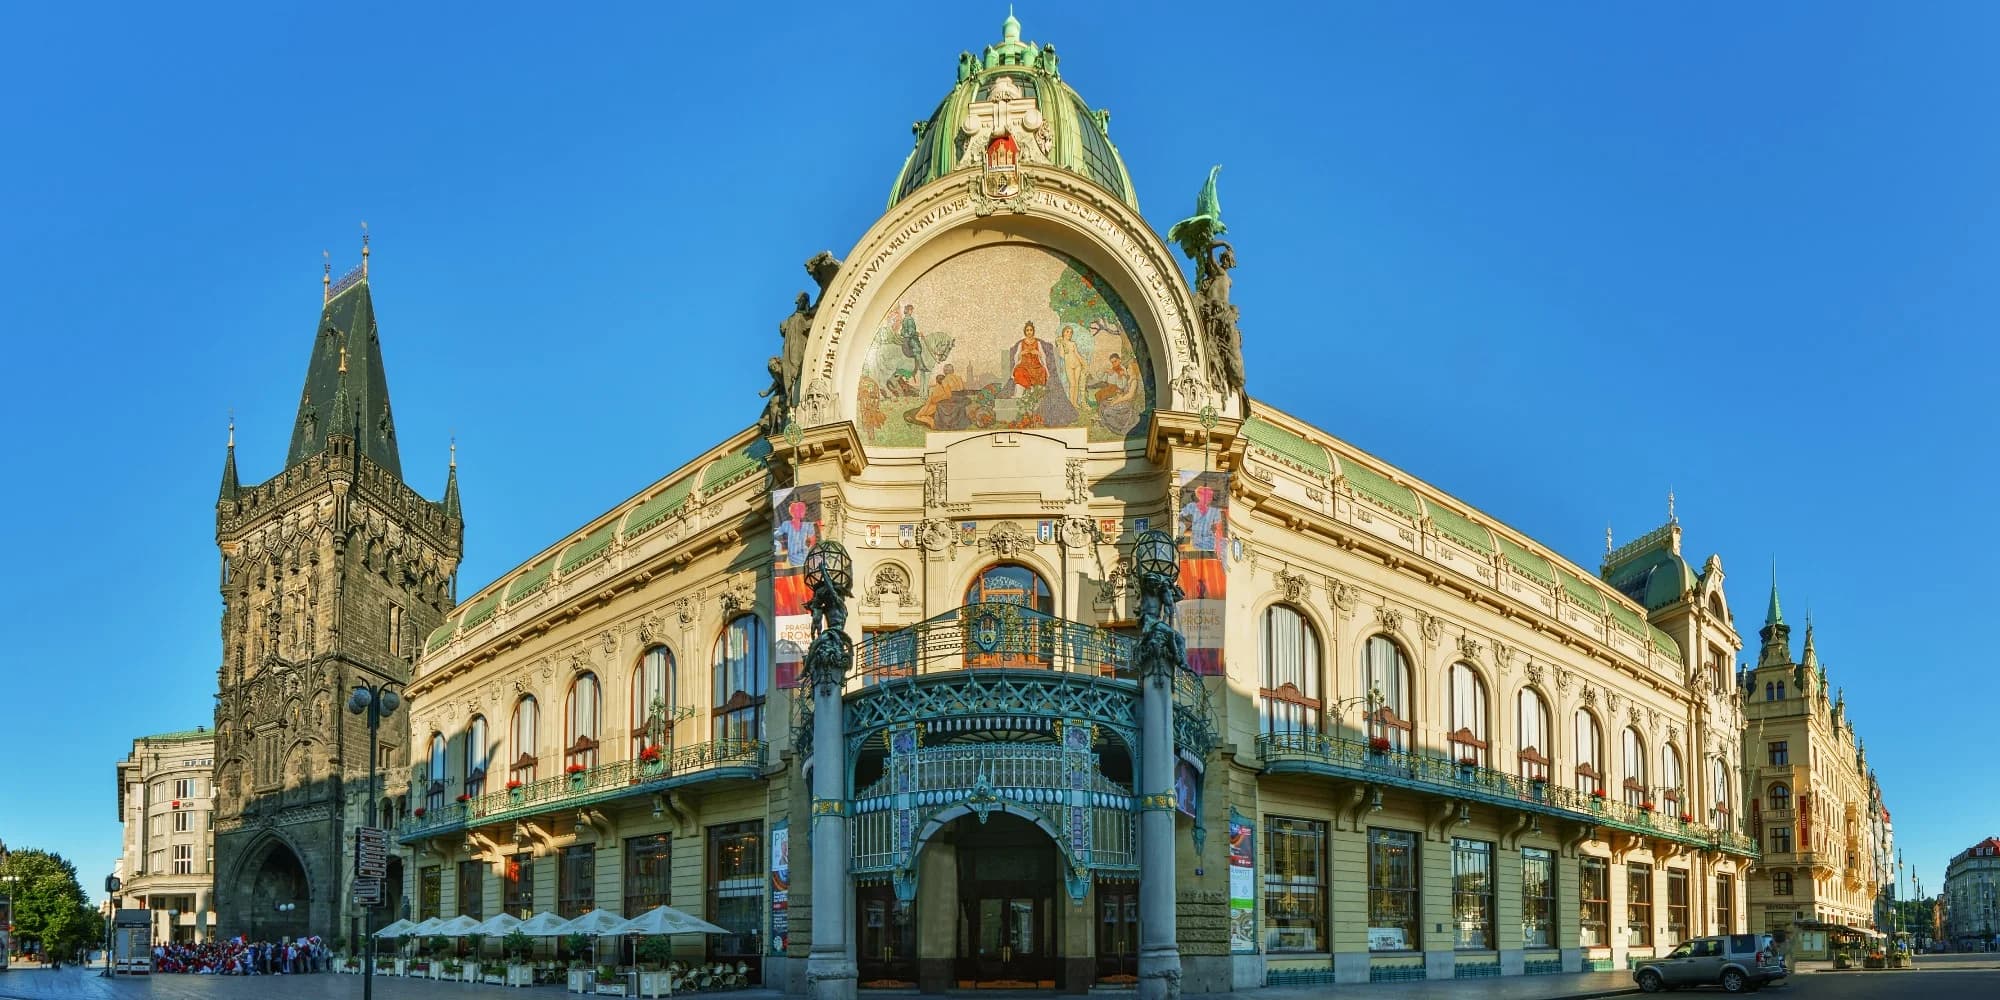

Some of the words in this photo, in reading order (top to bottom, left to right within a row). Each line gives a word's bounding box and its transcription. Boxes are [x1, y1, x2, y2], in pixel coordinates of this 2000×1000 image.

[1181, 615, 1221, 625] PROMS
[785, 623, 811, 632] PRAGU
[780, 631, 811, 641] PROM
